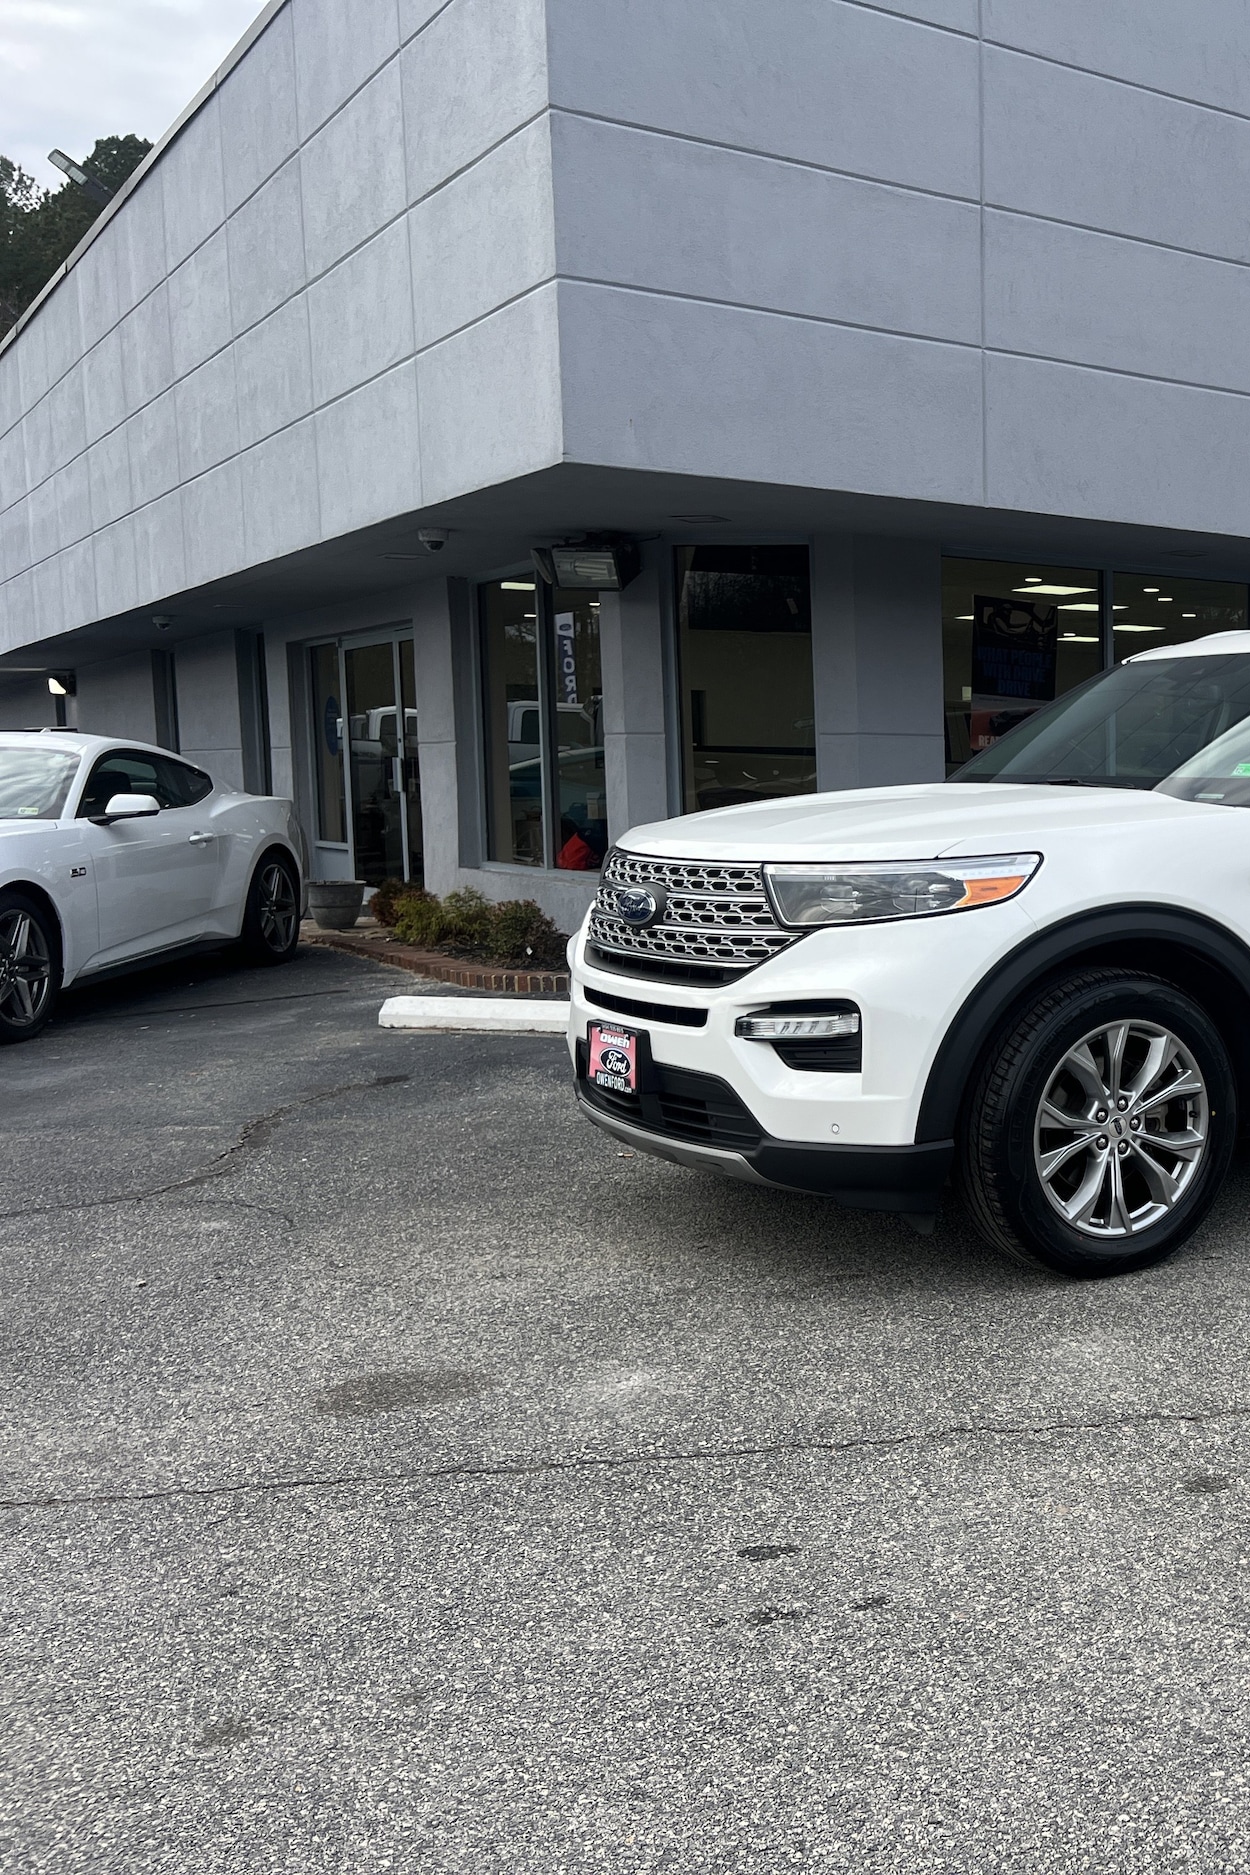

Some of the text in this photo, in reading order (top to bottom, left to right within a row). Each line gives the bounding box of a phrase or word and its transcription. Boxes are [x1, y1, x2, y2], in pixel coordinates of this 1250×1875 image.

[977, 646, 1052, 668] WHAT PEOPLE
[983, 663, 1046, 683] WITH DRIVE
[998, 680, 1031, 697] DRIVE
[606, 1051, 627, 1073] Ford
